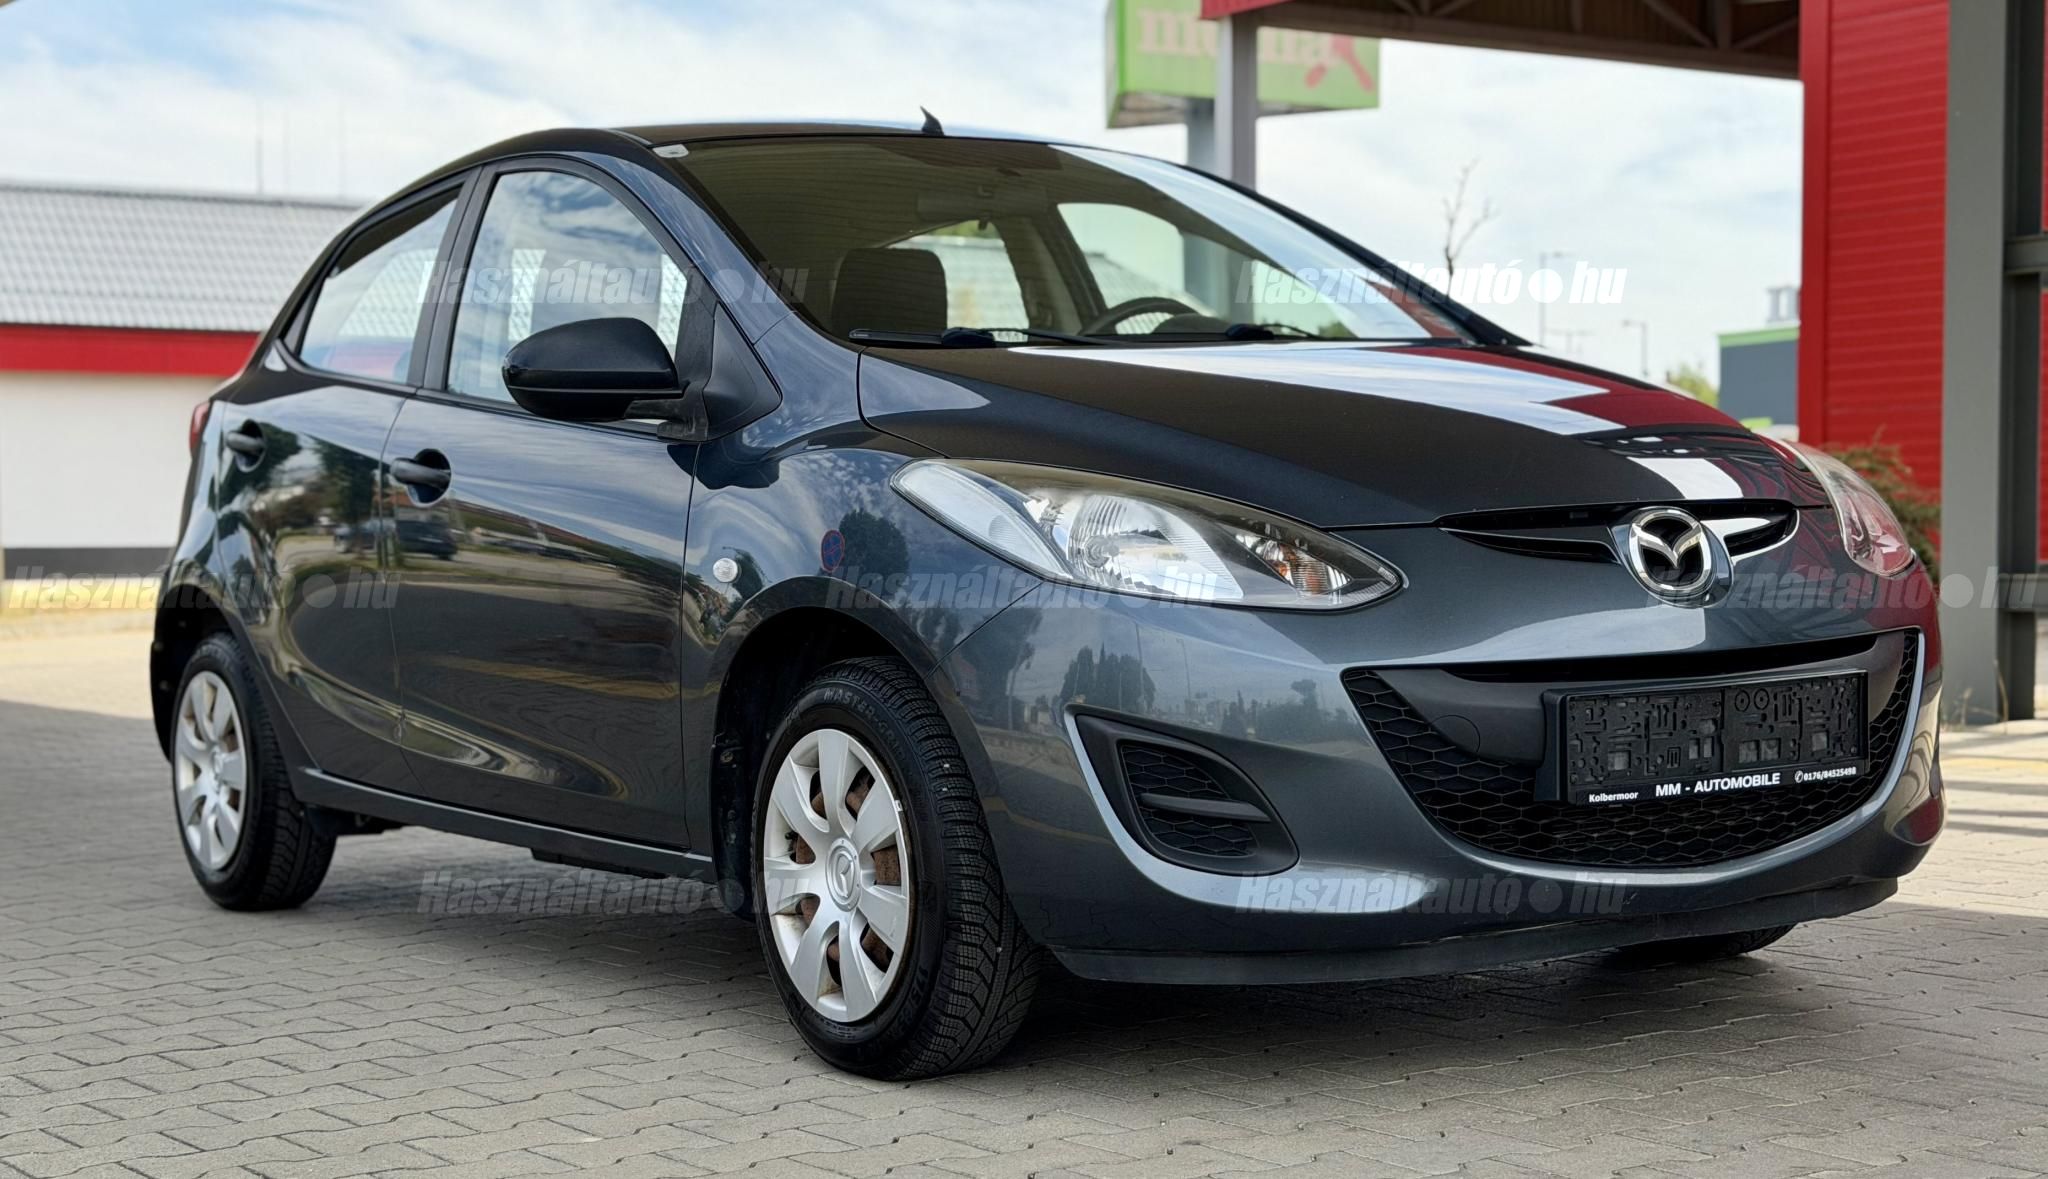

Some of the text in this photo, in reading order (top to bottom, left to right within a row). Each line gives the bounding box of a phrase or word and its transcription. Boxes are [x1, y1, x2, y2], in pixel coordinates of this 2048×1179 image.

[1655, 782, 1682, 797] MM
[1694, 772, 1781, 794] AUTOMOBILE
[1588, 791, 1639, 803] Kolbermoor
